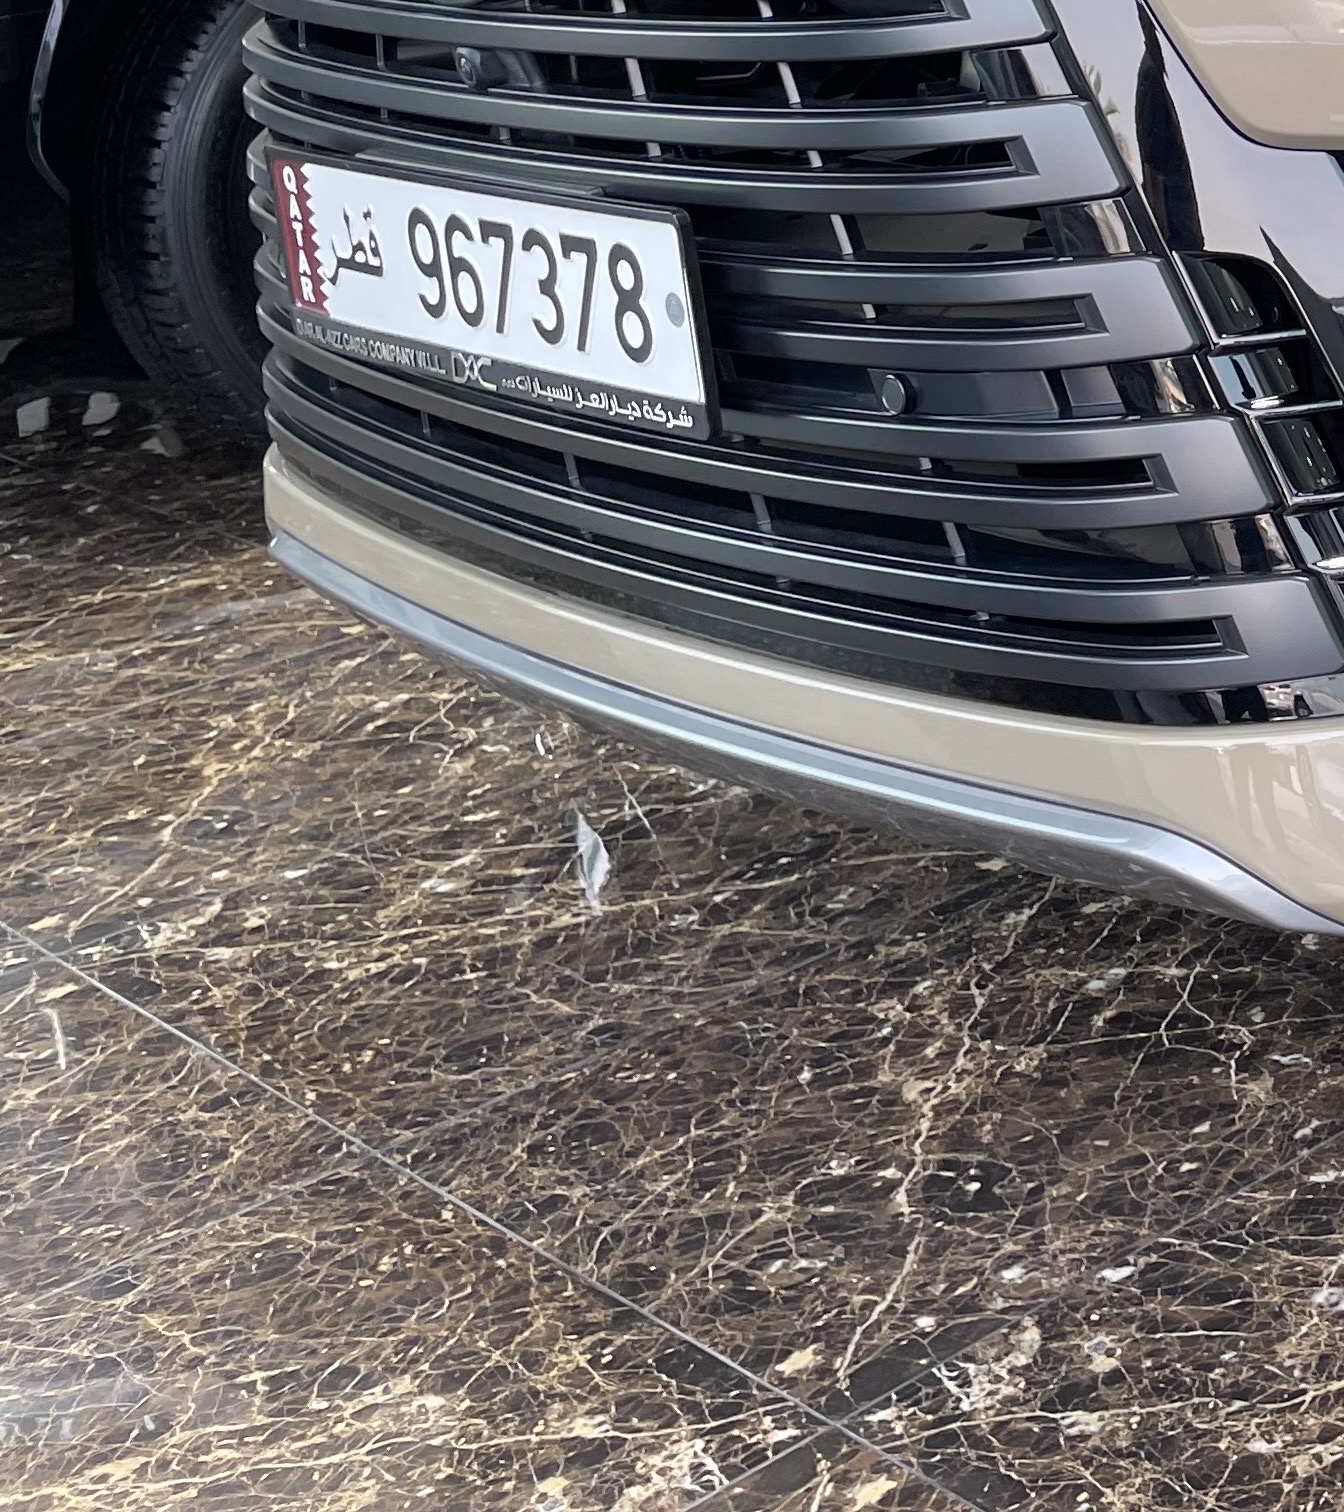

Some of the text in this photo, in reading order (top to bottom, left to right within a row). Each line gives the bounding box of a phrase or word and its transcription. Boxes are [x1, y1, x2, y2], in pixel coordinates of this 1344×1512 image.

[282, 165, 316, 303] QATAR
[324, 205, 384, 286] قطر
[407, 206, 653, 364] 967378
[368, 339, 415, 368] COMPANY
[515, 375, 575, 403] للسيارات
[575, 387, 609, 410] العز
[608, 394, 642, 422] ديار
[642, 399, 694, 429] شركة
